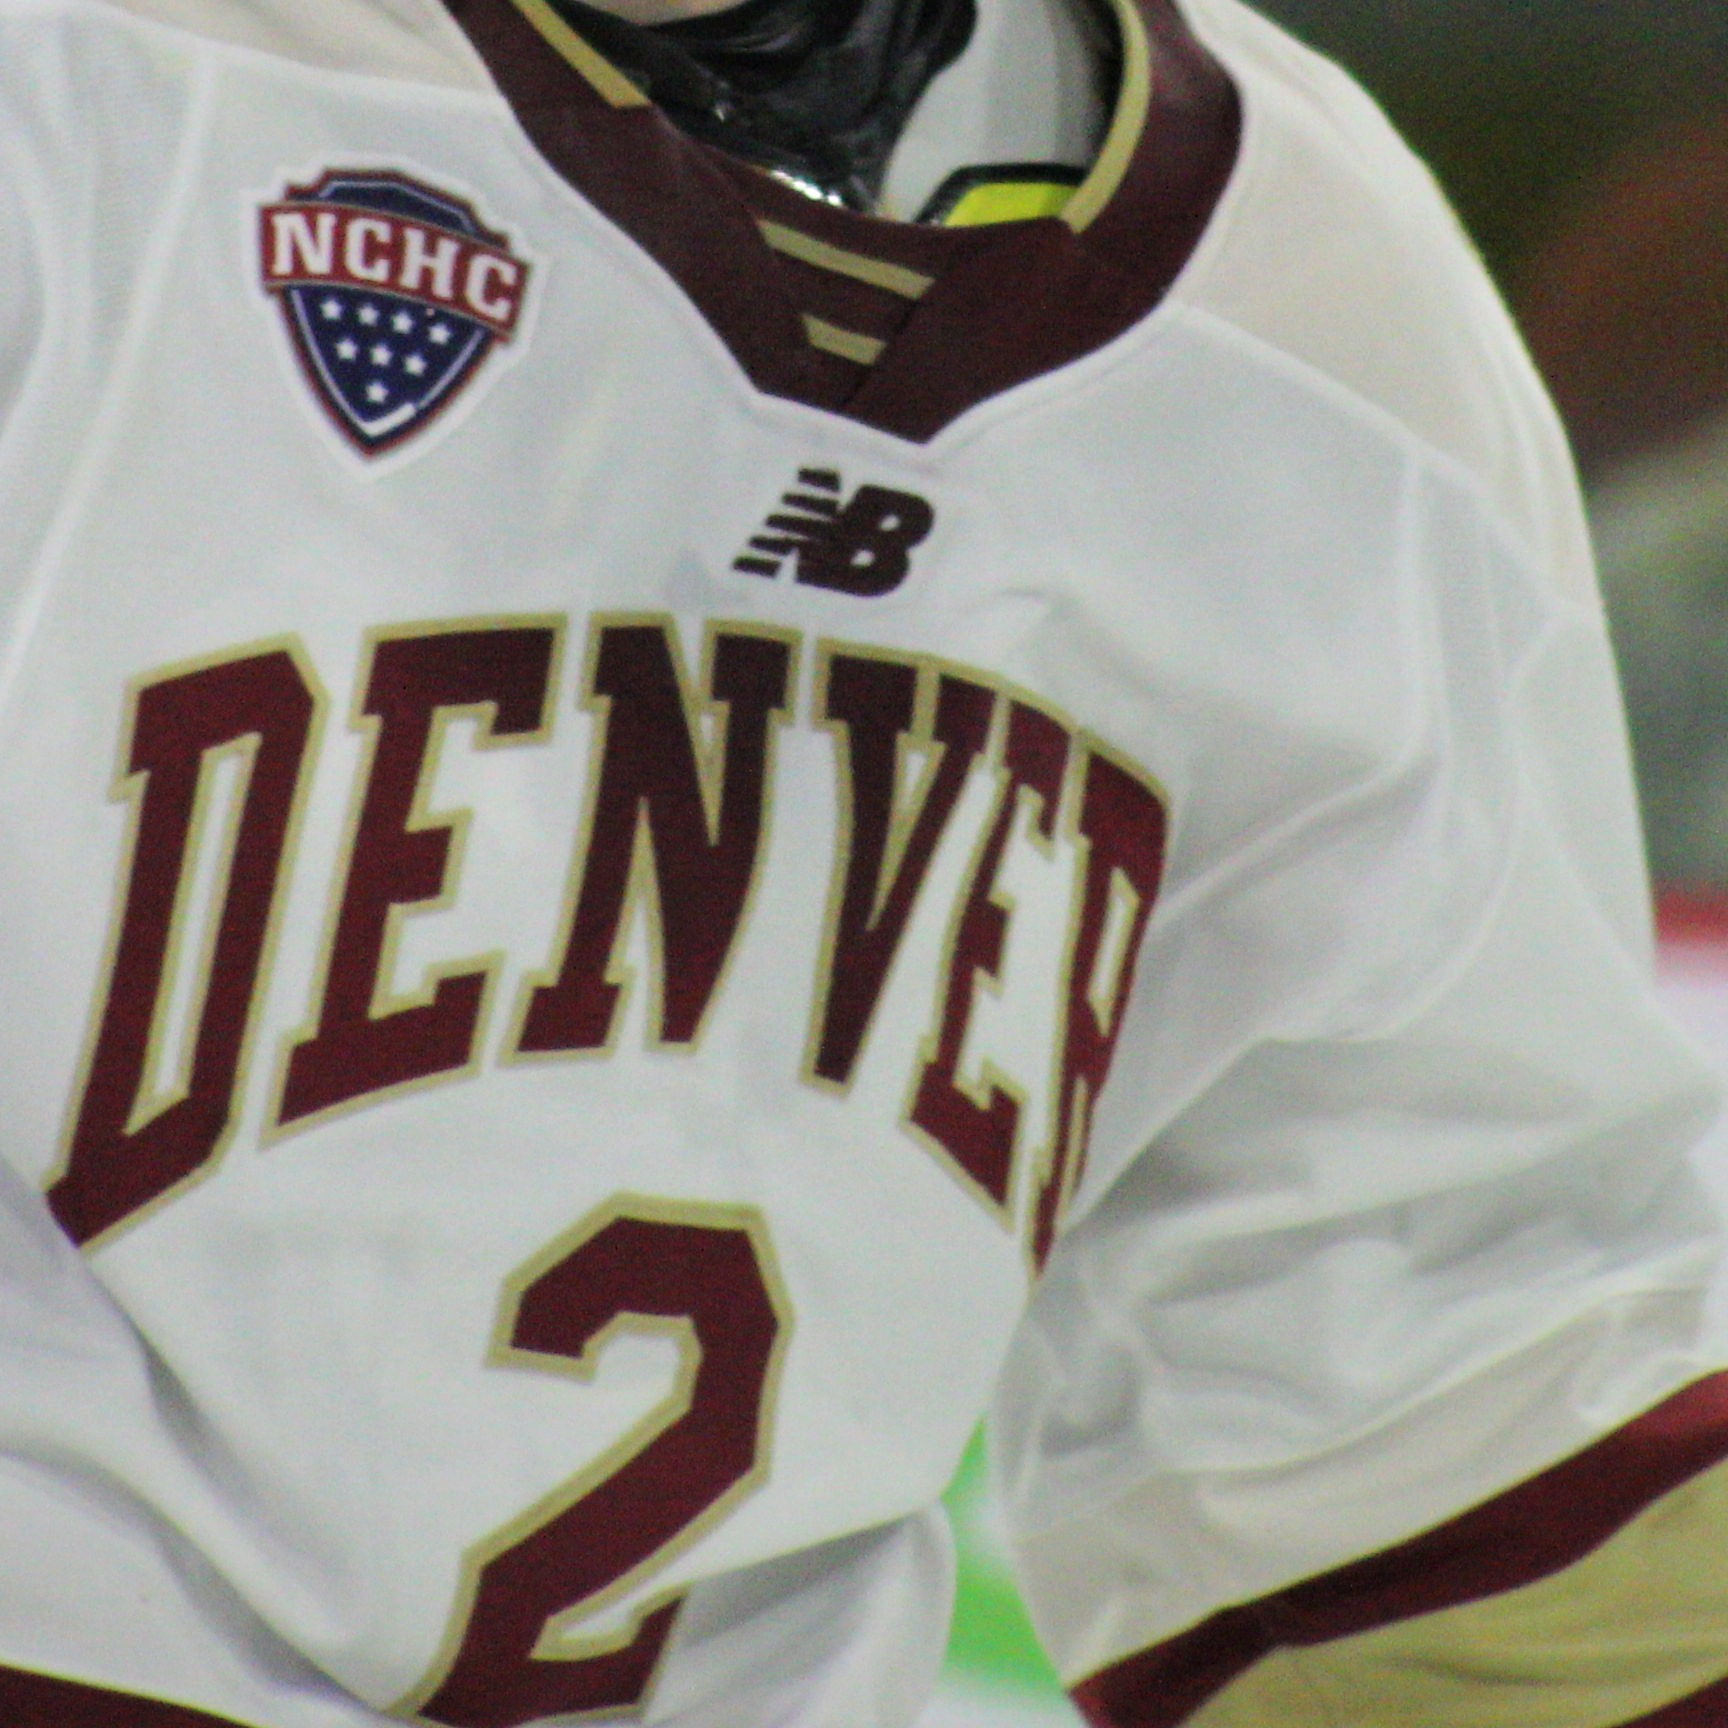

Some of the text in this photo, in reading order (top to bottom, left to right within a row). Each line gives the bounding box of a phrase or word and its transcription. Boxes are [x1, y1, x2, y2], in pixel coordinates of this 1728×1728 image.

[272, 212, 518, 320] NCHC
[44, 612, 1172, 1284] DENVER
[384, 1190, 795, 1728] 2
